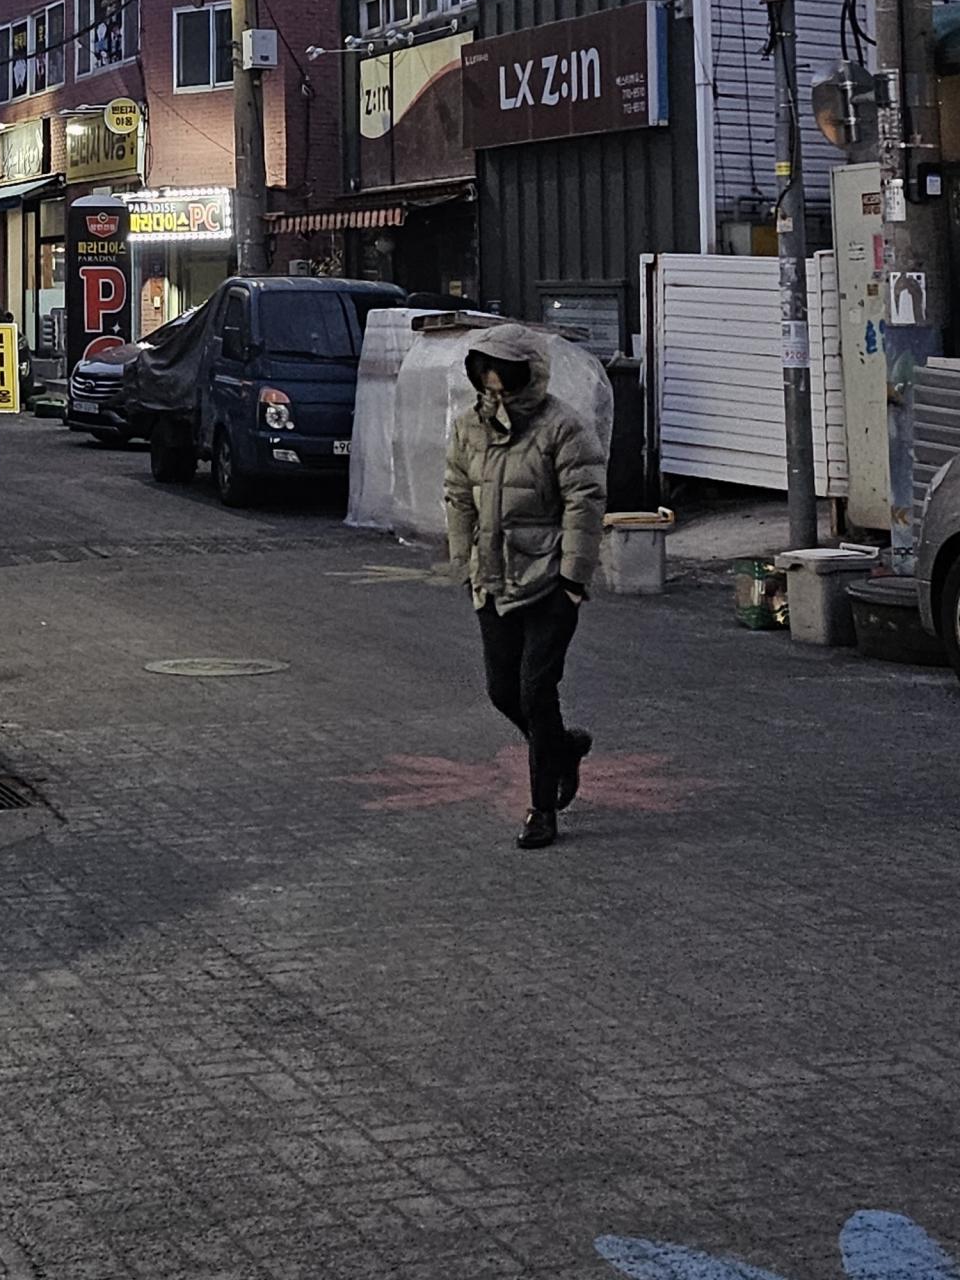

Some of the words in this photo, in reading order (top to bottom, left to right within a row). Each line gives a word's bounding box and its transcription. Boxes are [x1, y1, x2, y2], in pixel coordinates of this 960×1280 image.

[499, 59, 535, 110] LX
[128, 202, 177, 213] PARADISE
[129, 212, 189, 233] 파라다이스
[188, 202, 221, 232] PC
[77, 241, 127, 255] 파라다이스
